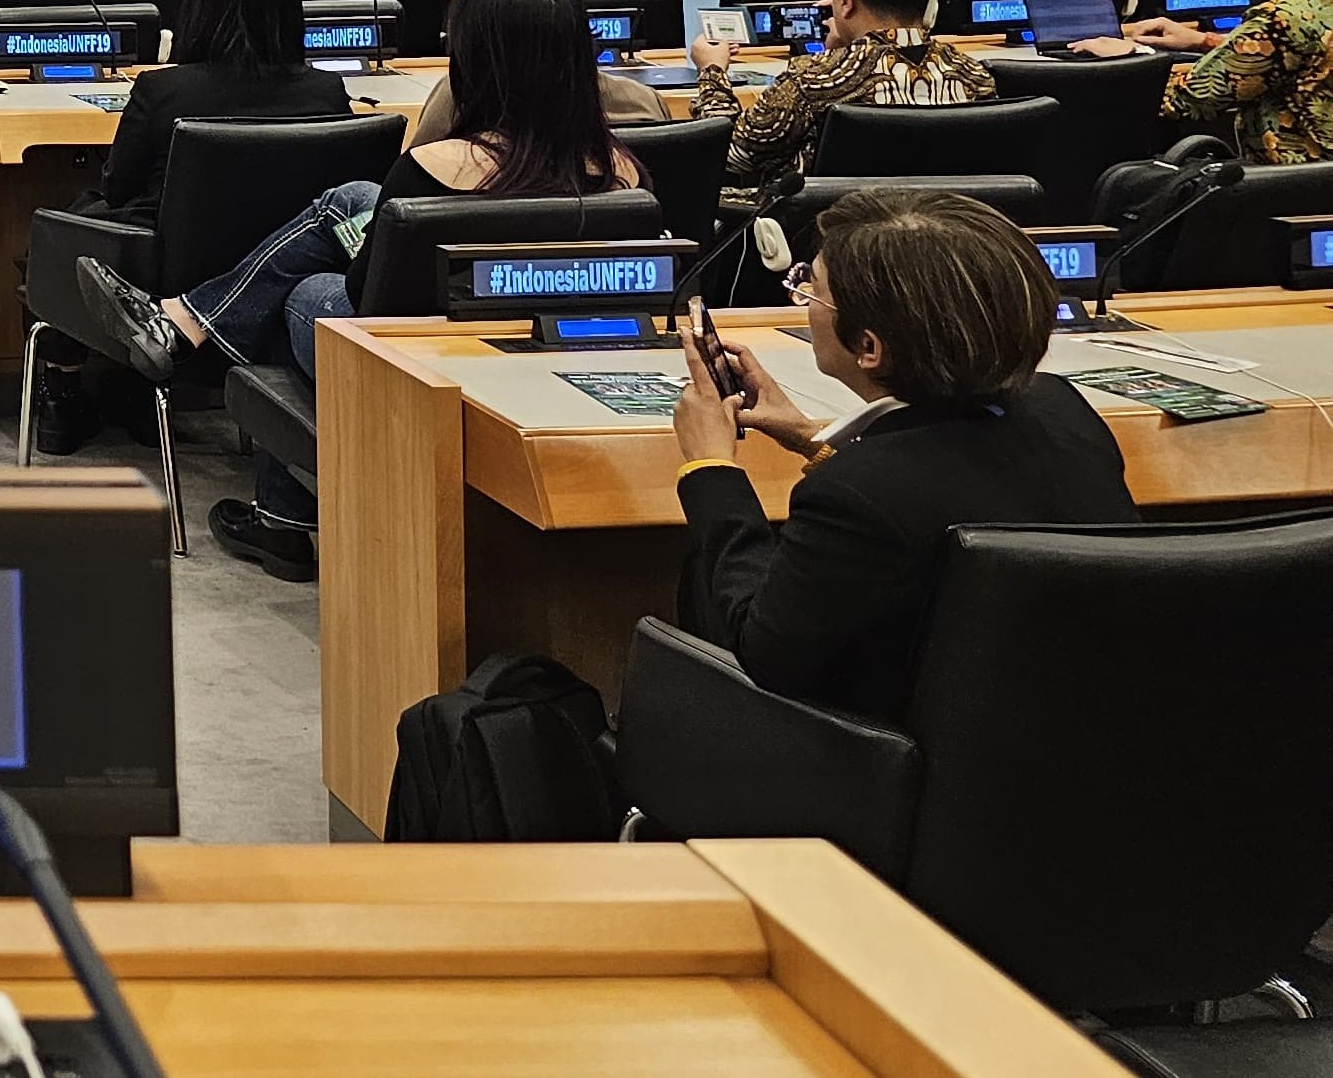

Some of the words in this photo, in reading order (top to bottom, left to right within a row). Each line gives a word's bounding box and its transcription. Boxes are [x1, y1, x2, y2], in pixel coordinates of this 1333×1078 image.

[979, 2, 1028, 20] #Indonesia
[6, 33, 111, 54] #IndonesiaUNFF19
[304, 27, 372, 48] nesiaUNFF19
[490, 260, 657, 295] #IndonesiaUNFF19
